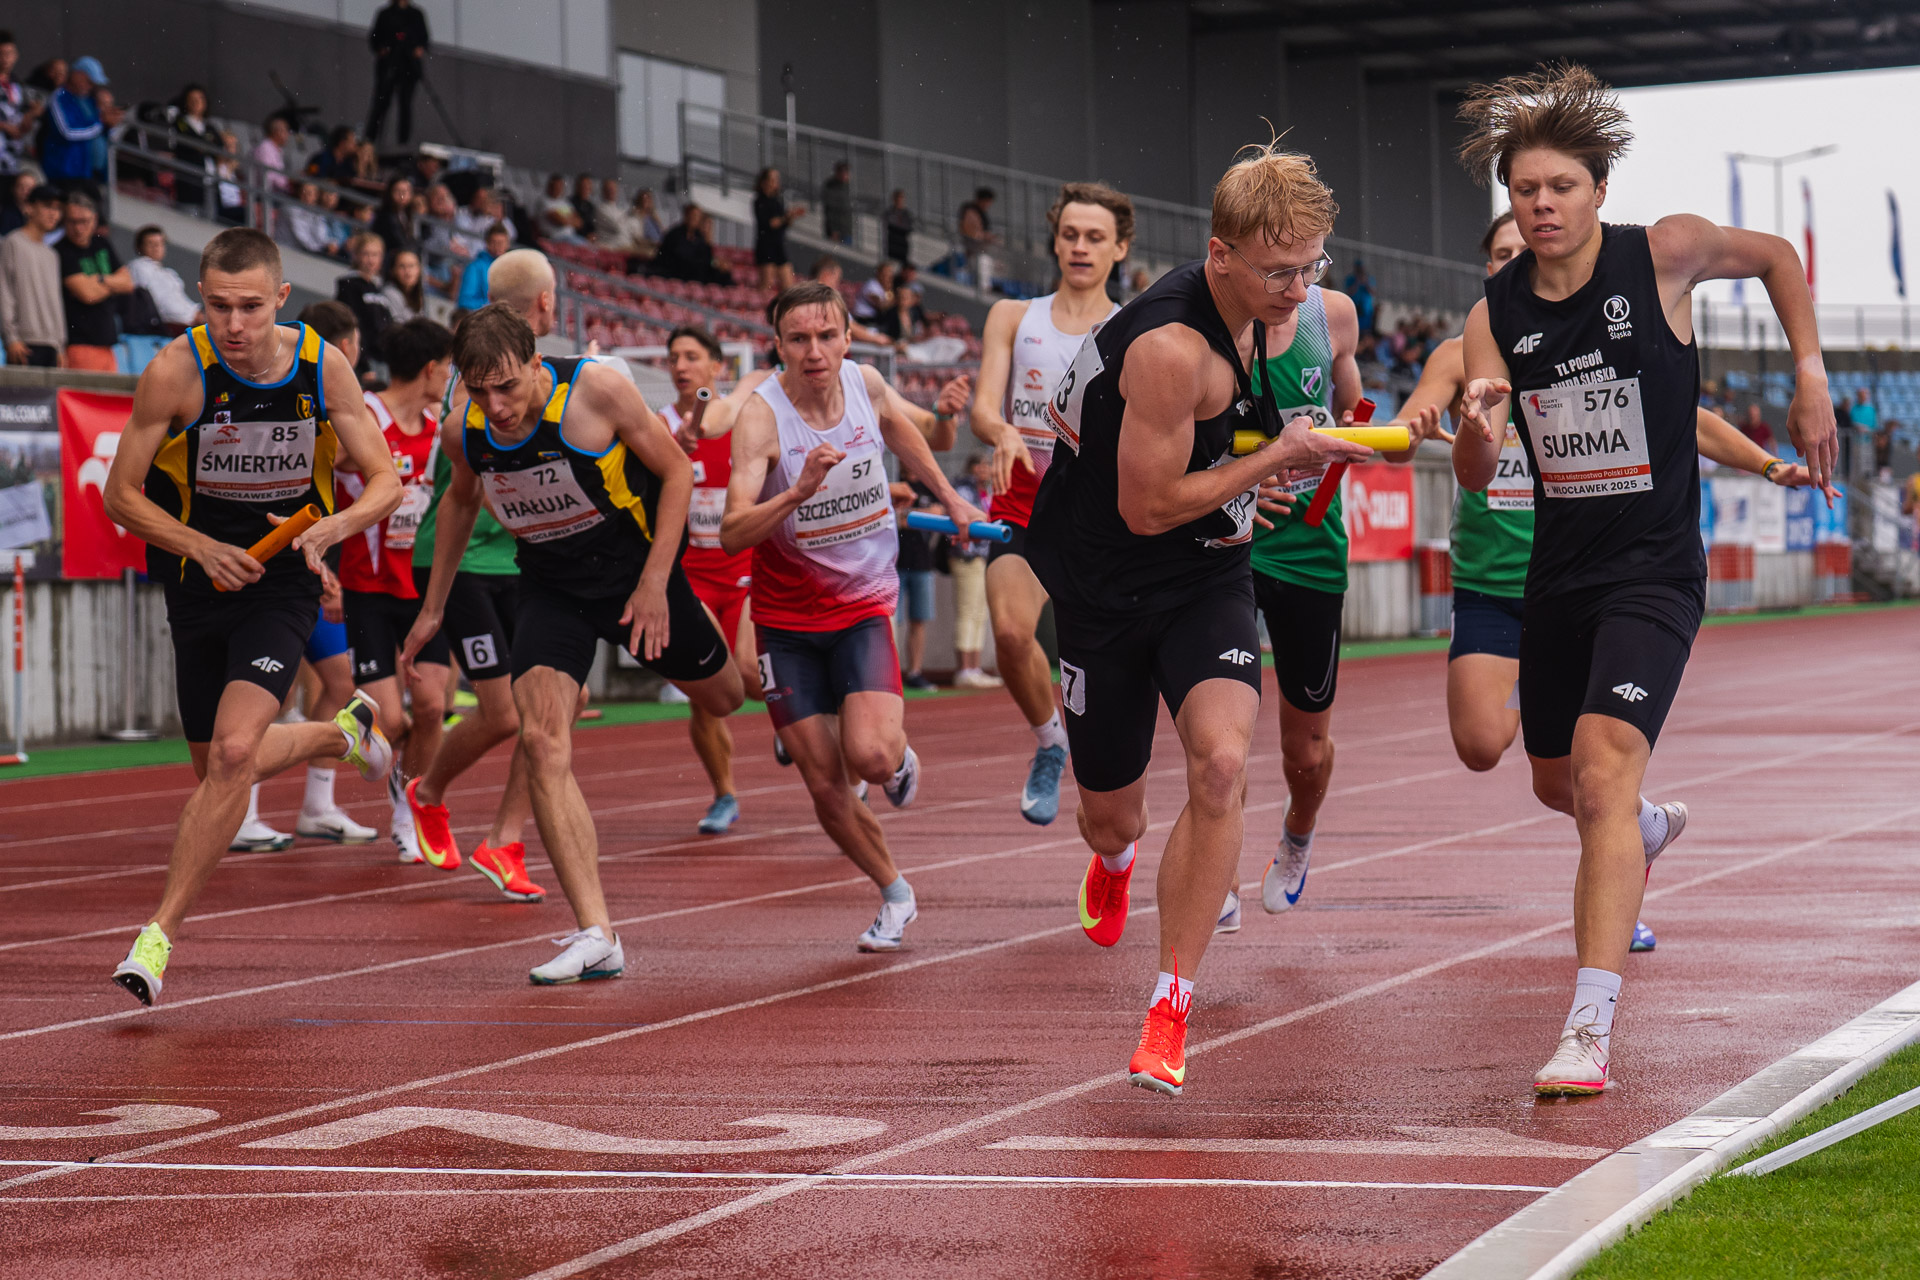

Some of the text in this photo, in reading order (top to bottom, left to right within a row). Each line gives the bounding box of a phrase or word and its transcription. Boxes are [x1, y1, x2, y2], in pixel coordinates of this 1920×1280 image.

[1608, 321, 1632, 332] RUDA
[1513, 332, 1543, 354] 4F
[1555, 348, 1604, 377] TL POGOŃ
[1057, 359, 1076, 413] 3
[1584, 386, 1629, 412] 576
[272, 426, 298, 442] 85
[1052, 423, 1071, 444] 2025
[1543, 428, 1630, 459] SURMA
[201, 451, 307, 473] ŚMIERTKA
[852, 459, 871, 479] 57
[533, 468, 560, 486] 72
[1566, 472, 1602, 480] Mistrzostwa
[1604, 470, 1623, 478] Polski
[1624, 467, 1638, 475] U20
[208, 489, 299, 499] WŁOCŁAWEK 2025
[1552, 480, 1637, 495] WŁOCŁAWEK 2025
[502, 493, 580, 519] HAŁUJA
[797, 483, 884, 522] SZCZERCZOWSKI
[807, 521, 881, 547] WŁOCŁAWEK 2025
[472, 639, 489, 664] 6
[1219, 648, 1255, 666] 4F
[251, 656, 284, 673] 4F
[1063, 665, 1077, 703] 7
[1612, 682, 1648, 703] 4F
